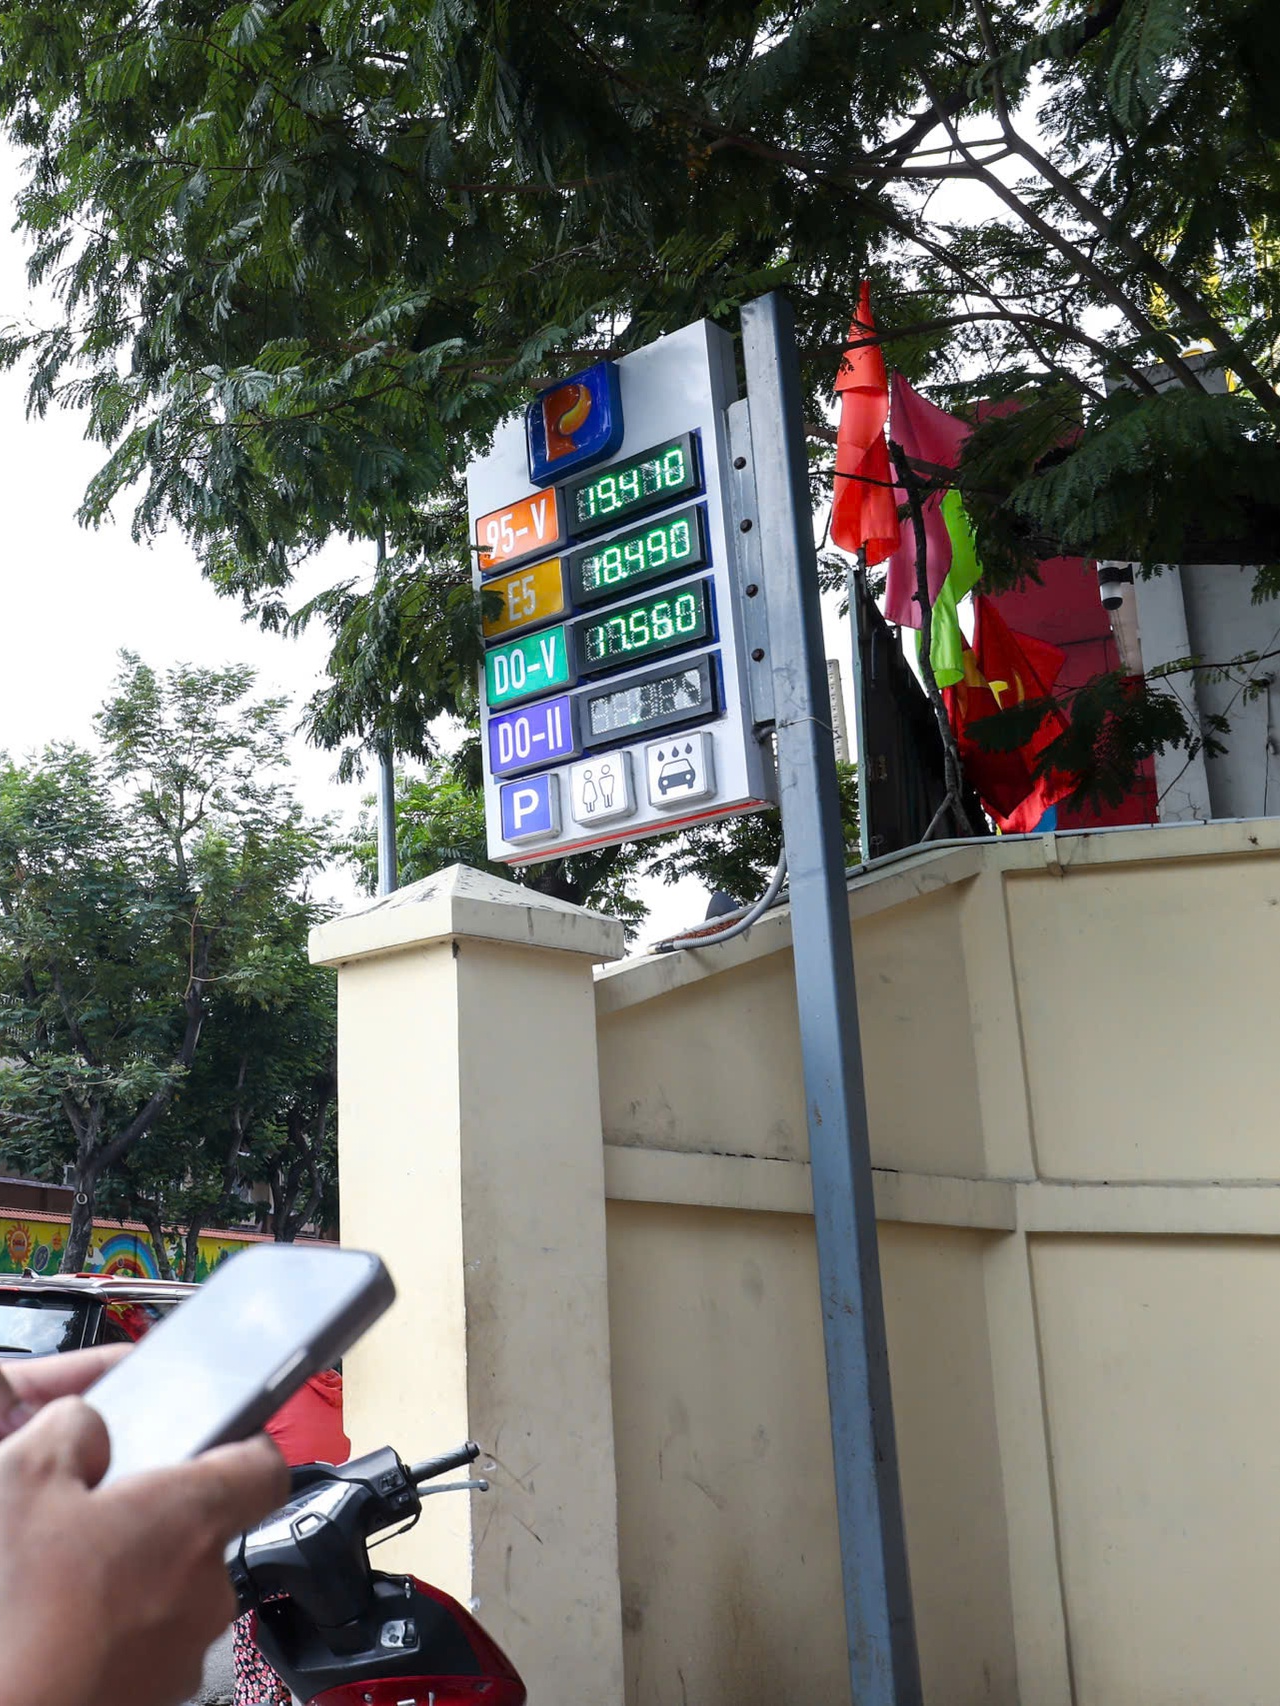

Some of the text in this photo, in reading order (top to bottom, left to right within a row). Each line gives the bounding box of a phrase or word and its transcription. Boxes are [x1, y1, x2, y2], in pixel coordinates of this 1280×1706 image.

[588, 449, 685, 516] 19.410
[486, 498, 546, 559] 95-V
[594, 521, 690, 586] 18.490
[507, 575, 536, 621] E5
[598, 594, 696, 657] 17.560
[494, 636, 556, 696] DO-V
[498, 706, 563, 764] DO-II
[513, 788, 540, 829] P
